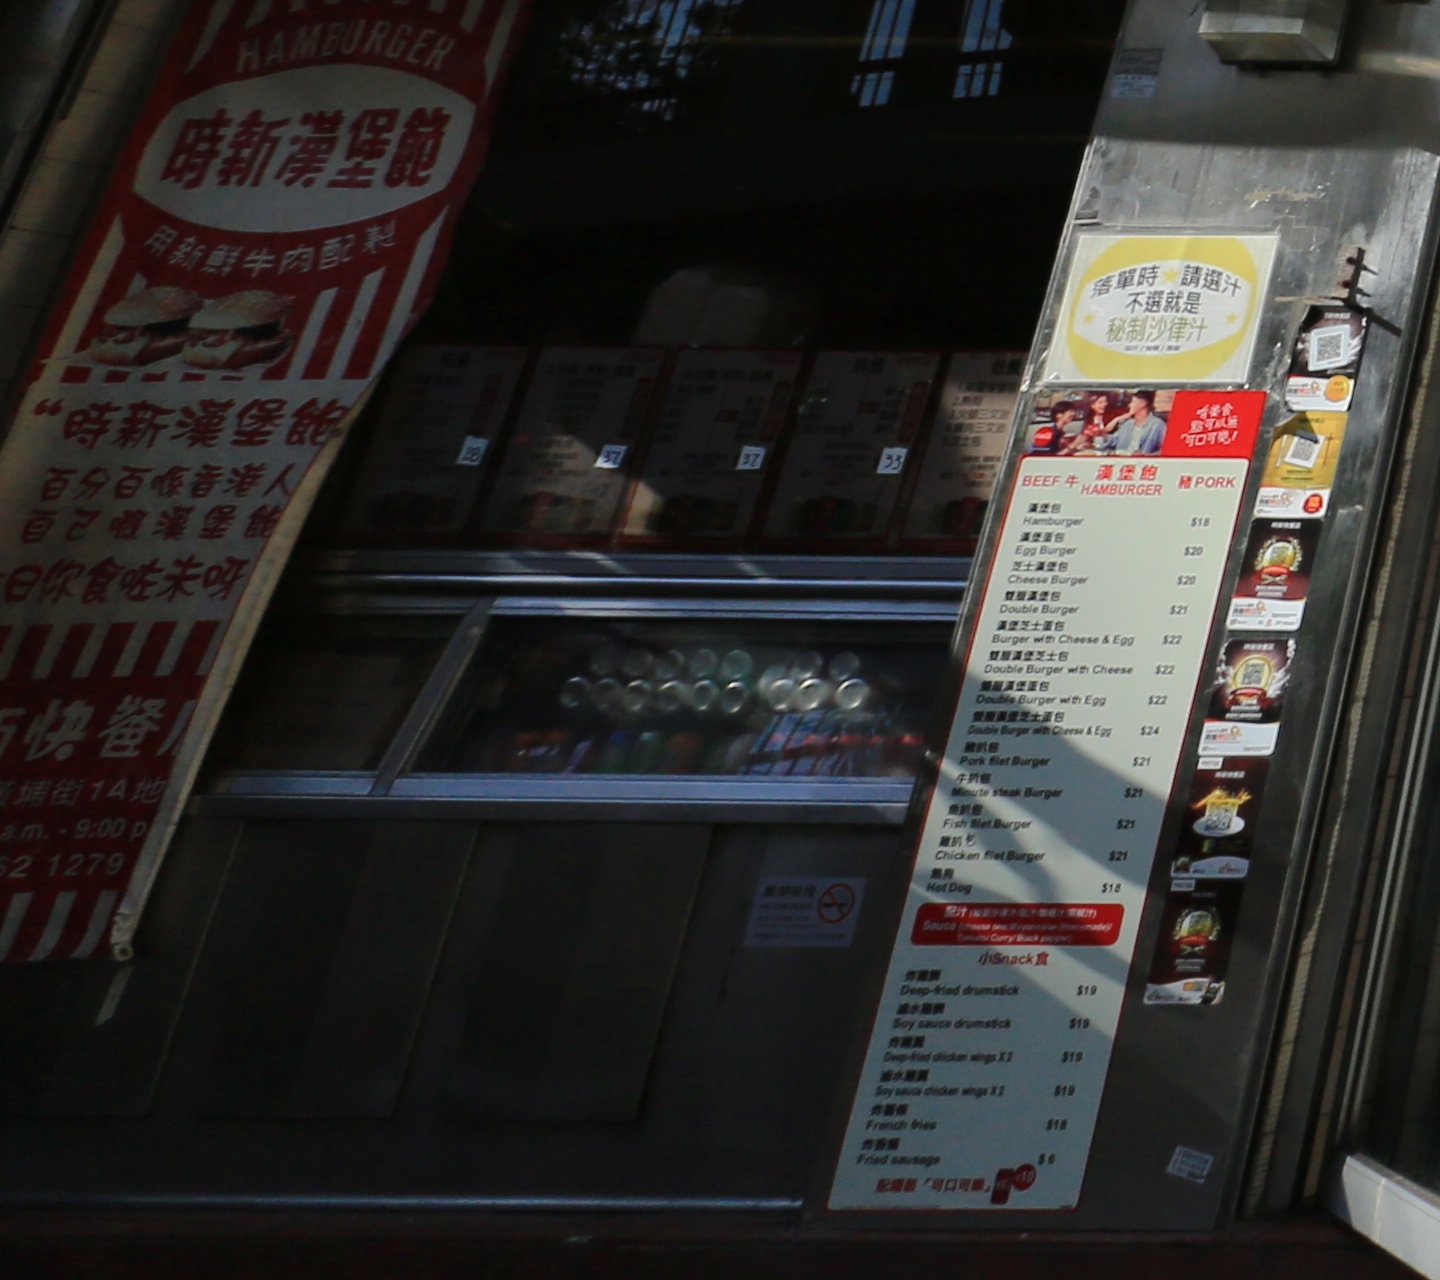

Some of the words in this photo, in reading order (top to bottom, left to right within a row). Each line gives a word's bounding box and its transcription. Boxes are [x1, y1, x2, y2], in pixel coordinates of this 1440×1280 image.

[236, 19, 456, 73] HAMBURGER
[160, 106, 452, 190] 時新漢堡飽
[143, 217, 397, 278] 用新鮮牛肉配製
[1090, 265, 1160, 297] 落單時
[1180, 264, 1242, 297] 請選汁
[1125, 290, 1201, 314] 不選就是
[1106, 315, 1208, 343] 秘制沙律汁
[1096, 465, 1158, 482] 漢堡飽
[1022, 475, 1061, 487] BEEF
[1065, 475, 1079, 488] 牛
[1194, 476, 1236, 488] PORK
[1080, 484, 1162, 496] HAMBURGER
[1023, 517, 1083, 527] Hamburger
[1191, 517, 1210, 527] $18
[1015, 546, 1037, 557] Egg
[1039, 546, 1077, 557] Burger
[1184, 546, 1203, 557] $20
[0, 555, 250, 605] 日你食咗未呀
[1008, 575, 1049, 585] Cheese
[1050, 575, 1089, 586] Burger
[1177, 576, 1196, 586] $20
[999, 605, 1038, 615] Double
[1041, 605, 1079, 616] Burger
[1170, 605, 1188, 615] $21
[992, 634, 1031, 646] Burger
[1033, 634, 1055, 644] with
[1058, 634, 1100, 645] Cheese
[1113, 635, 1135, 647] Egg
[1162, 635, 1182, 645] $22
[984, 664, 1023, 675] Double
[1026, 664, 1063, 676] Burger
[1067, 664, 1090, 675] with
[1093, 665, 1133, 675] Cheese
[1155, 665, 1175, 675] $22
[976, 695, 1016, 705] Double
[1018, 695, 1056, 707] Burger
[1059, 695, 1082, 705] with
[1085, 696, 1106, 707] Egg
[1148, 695, 1167, 705] $22
[1140, 726, 1160, 736] $24
[959, 757, 986, 766] Pork
[1012, 757, 1050, 768] Burger
[1132, 757, 1151, 767] $21
[1125, 788, 1143, 799] $21
[76, 819, 125, 840] 9:00
[943, 819, 967, 829] Fish
[994, 819, 1032, 831] Burger
[1117, 819, 1135, 830] $21
[935, 851, 980, 861] Chicken
[1007, 851, 1046, 863] Burger
[1109, 851, 1128, 861] $21
[46, 854, 123, 877] 1279
[1102, 883, 1121, 894] $18
